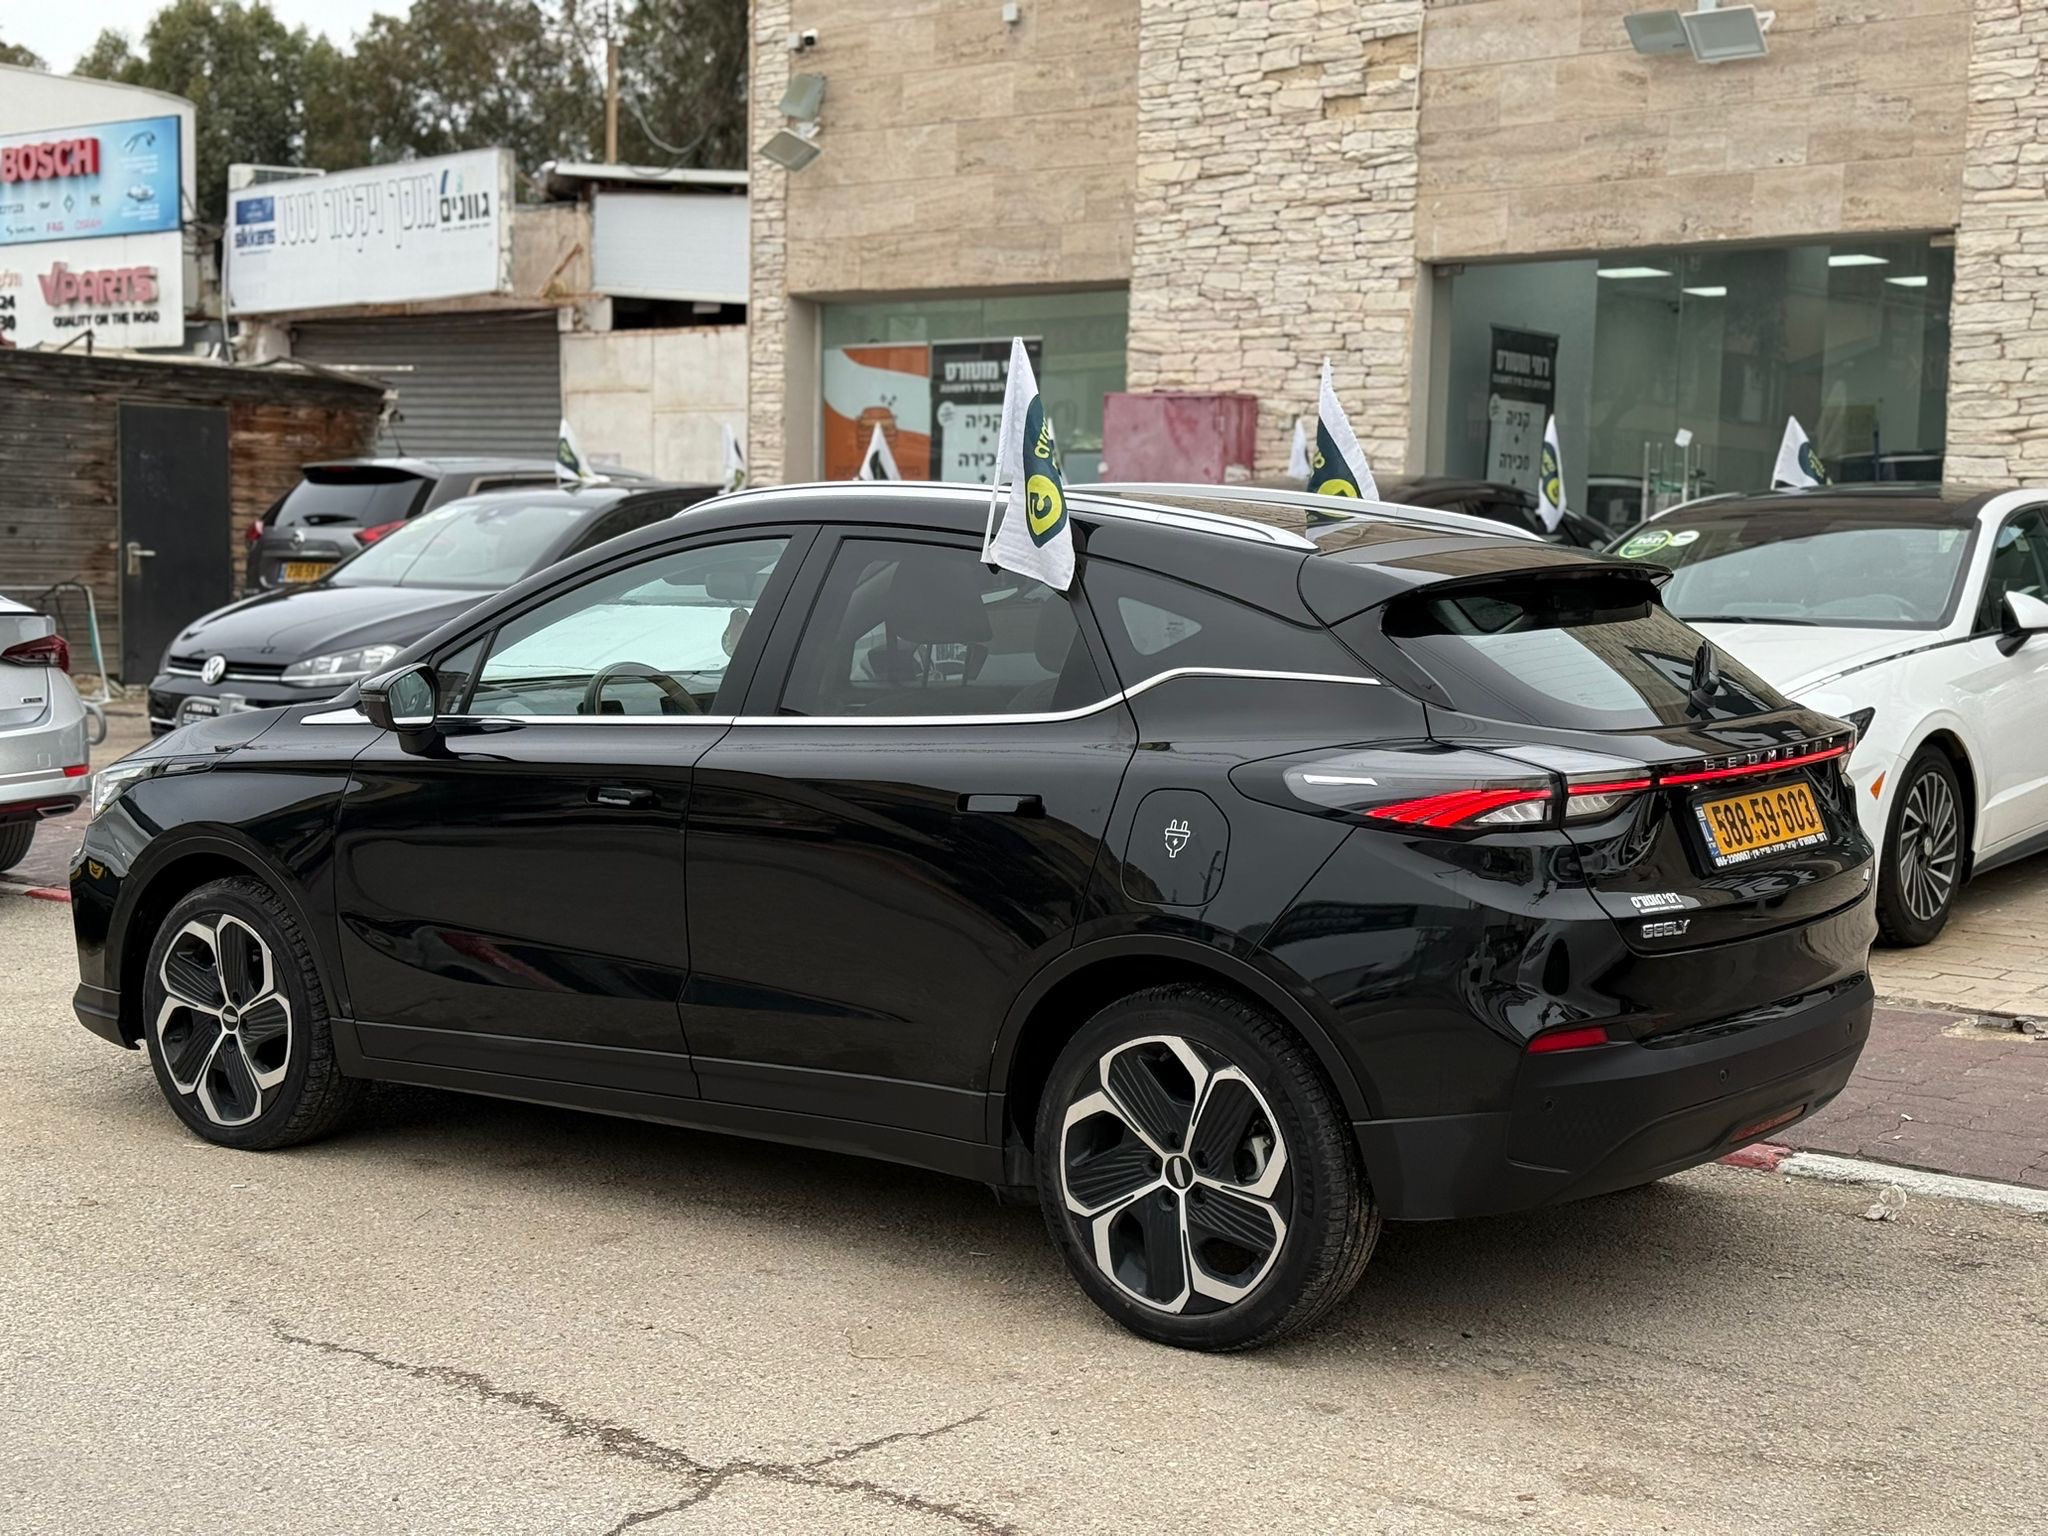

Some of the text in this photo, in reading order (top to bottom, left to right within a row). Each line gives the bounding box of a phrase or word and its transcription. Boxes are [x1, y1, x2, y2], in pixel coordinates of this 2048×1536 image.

[0, 138, 99, 183] BOSCH
[440, 191, 490, 222] גוונים
[53, 310, 160, 328] QUALITY ON THE ROAD
[944, 360, 1000, 381] מוטורס
[965, 414, 1002, 433] קניה
[1506, 410, 1531, 433] קניה
[958, 453, 997, 468] כירה
[1499, 453, 1530, 471] מכירה
[1642, 919, 1691, 939] GEELY
